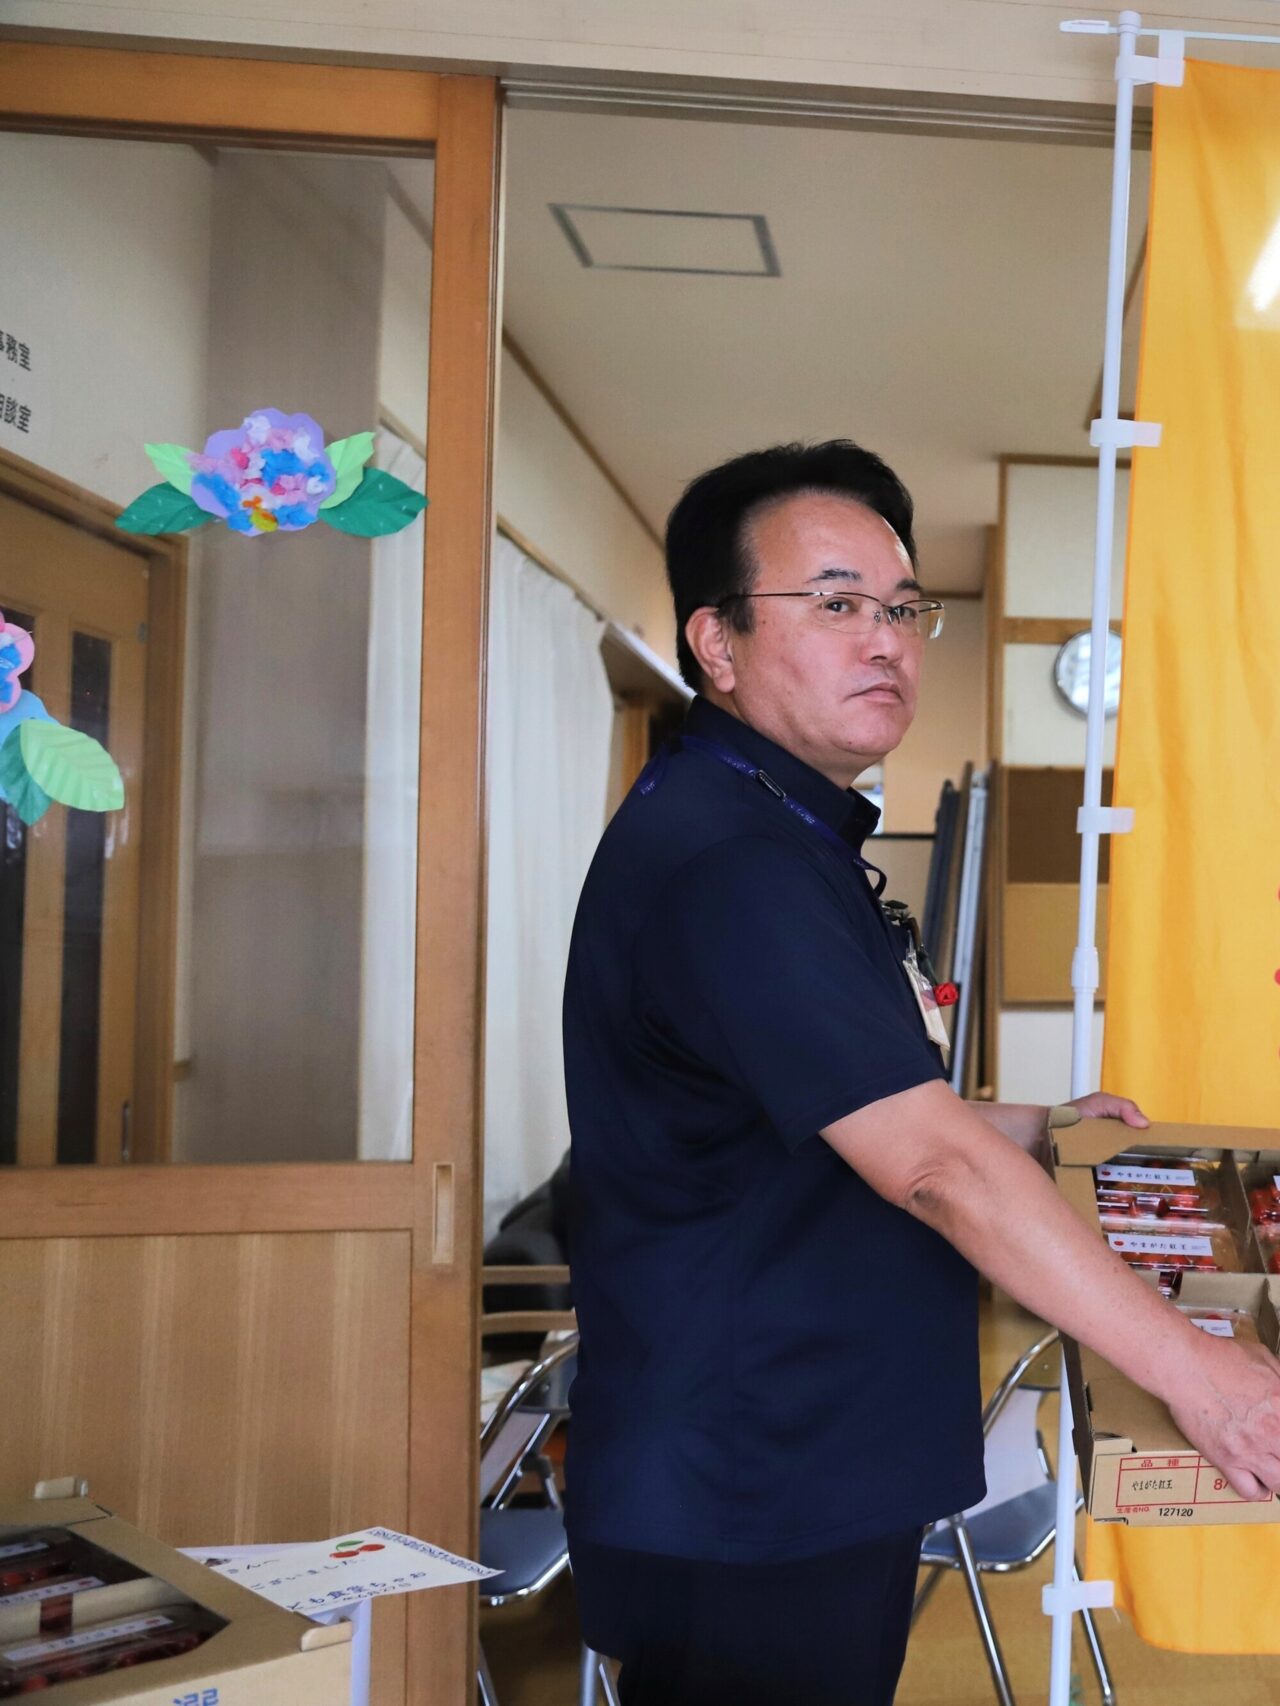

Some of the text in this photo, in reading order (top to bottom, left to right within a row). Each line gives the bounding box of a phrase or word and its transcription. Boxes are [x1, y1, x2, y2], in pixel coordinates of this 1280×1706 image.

[1132, 1479, 1173, 1491] やまがた紅王
[1158, 1507, 1194, 1517] 127120
